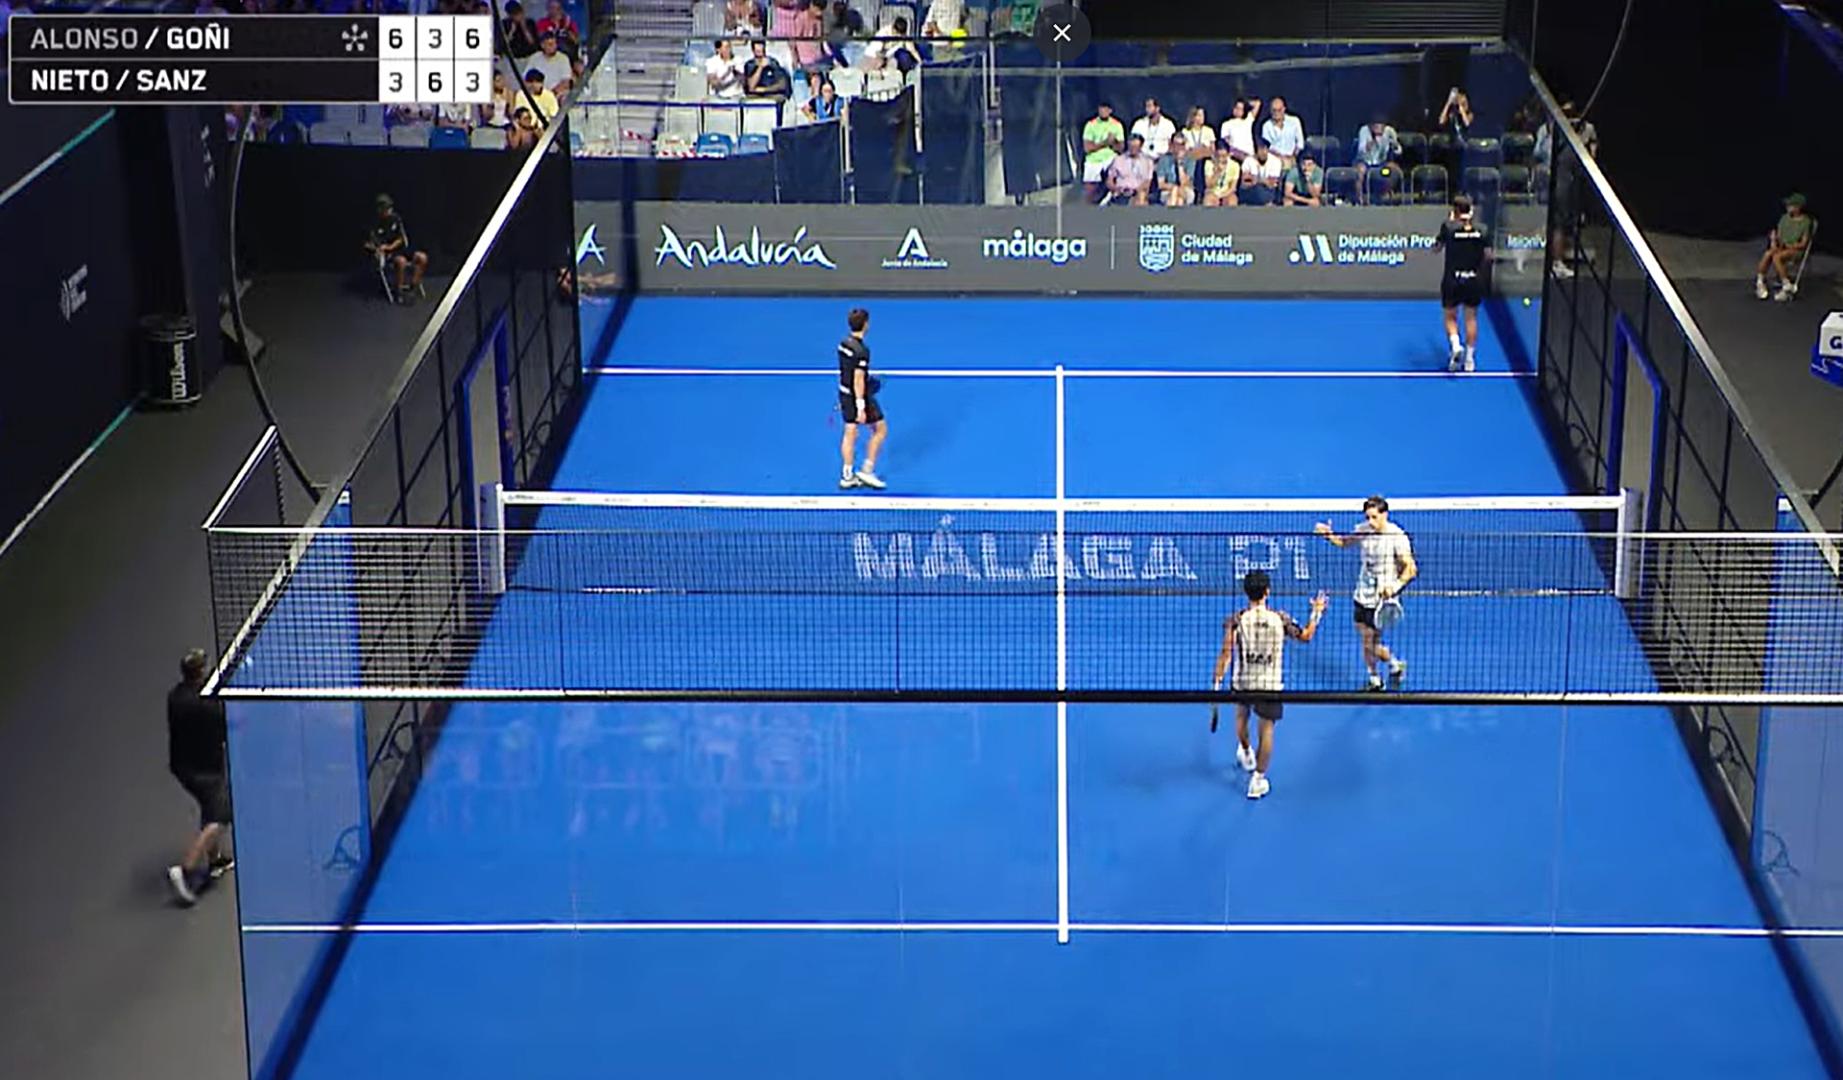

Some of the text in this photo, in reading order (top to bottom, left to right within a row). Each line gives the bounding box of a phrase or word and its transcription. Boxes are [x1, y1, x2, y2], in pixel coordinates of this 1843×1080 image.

[655, 224, 837, 269] Andalucía
[1181, 234, 1233, 248] Ciudad
[1338, 234, 1408, 250] Diputación
[1181, 249, 1254, 266] de Málaga
[1338, 249, 1405, 265] de Málaga
